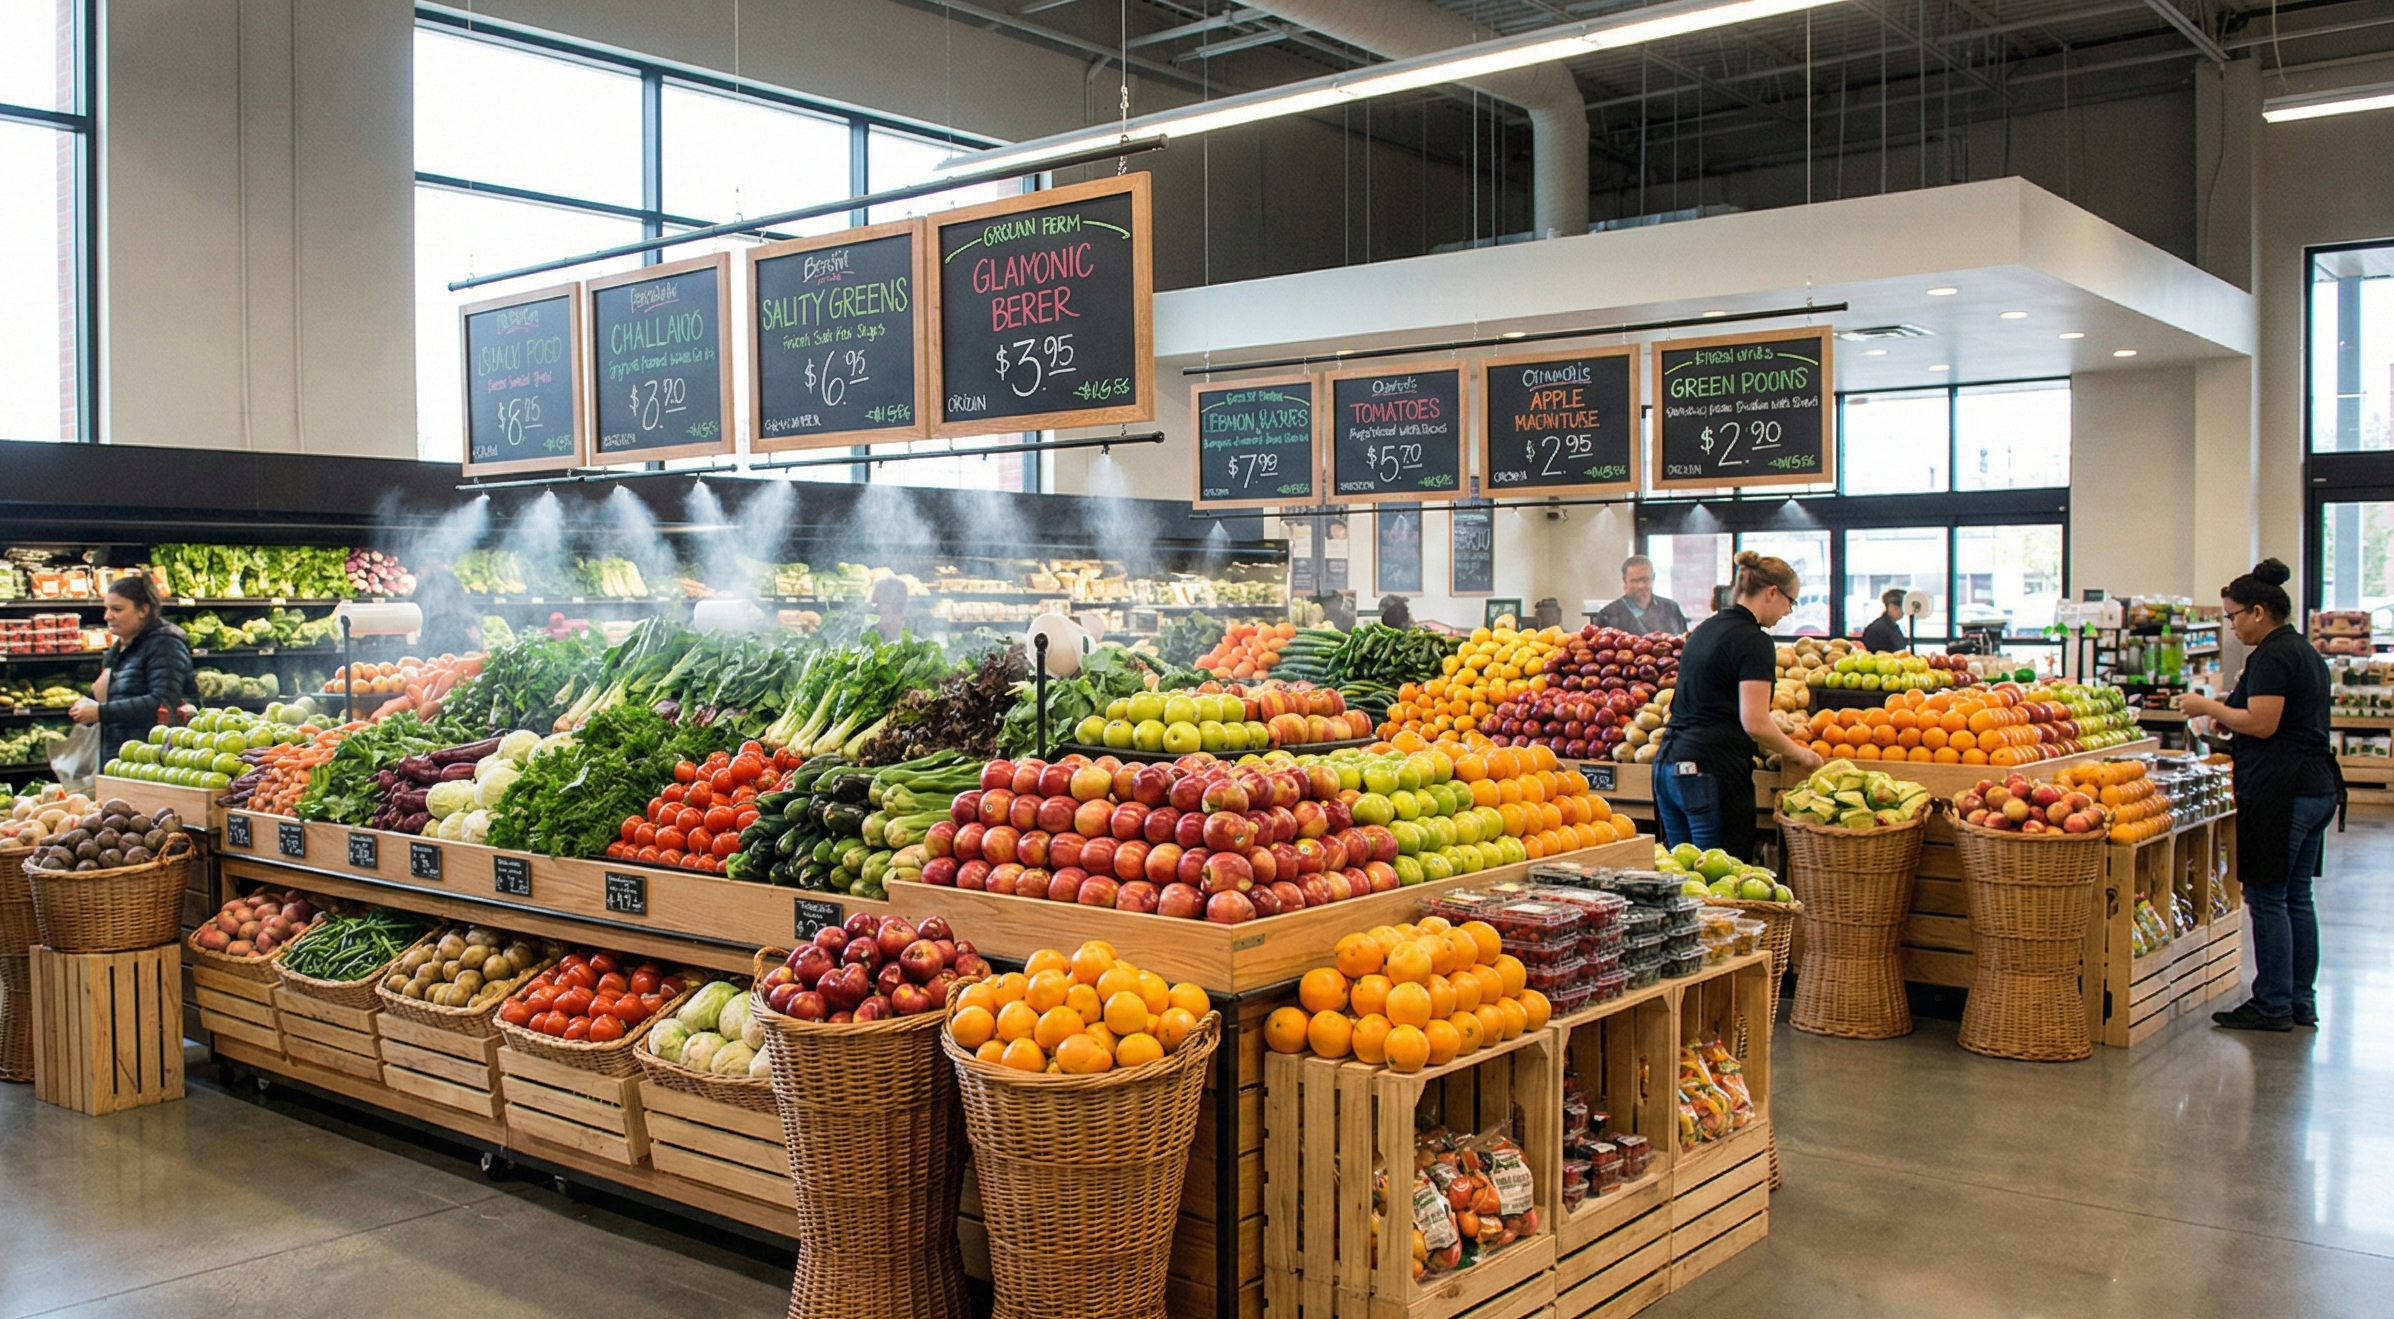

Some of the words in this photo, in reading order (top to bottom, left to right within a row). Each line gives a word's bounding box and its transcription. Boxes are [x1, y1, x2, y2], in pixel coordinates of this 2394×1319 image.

[763, 289, 826, 331] SALITY
[829, 277, 908, 320] GREENS
[991, 286, 1081, 332] BERER
[1671, 374, 1735, 398] GREEN
[1742, 367, 1809, 394] POONS
[1349, 397, 1441, 424] TOMATOES
[1530, 388, 1585, 411] APPLE
